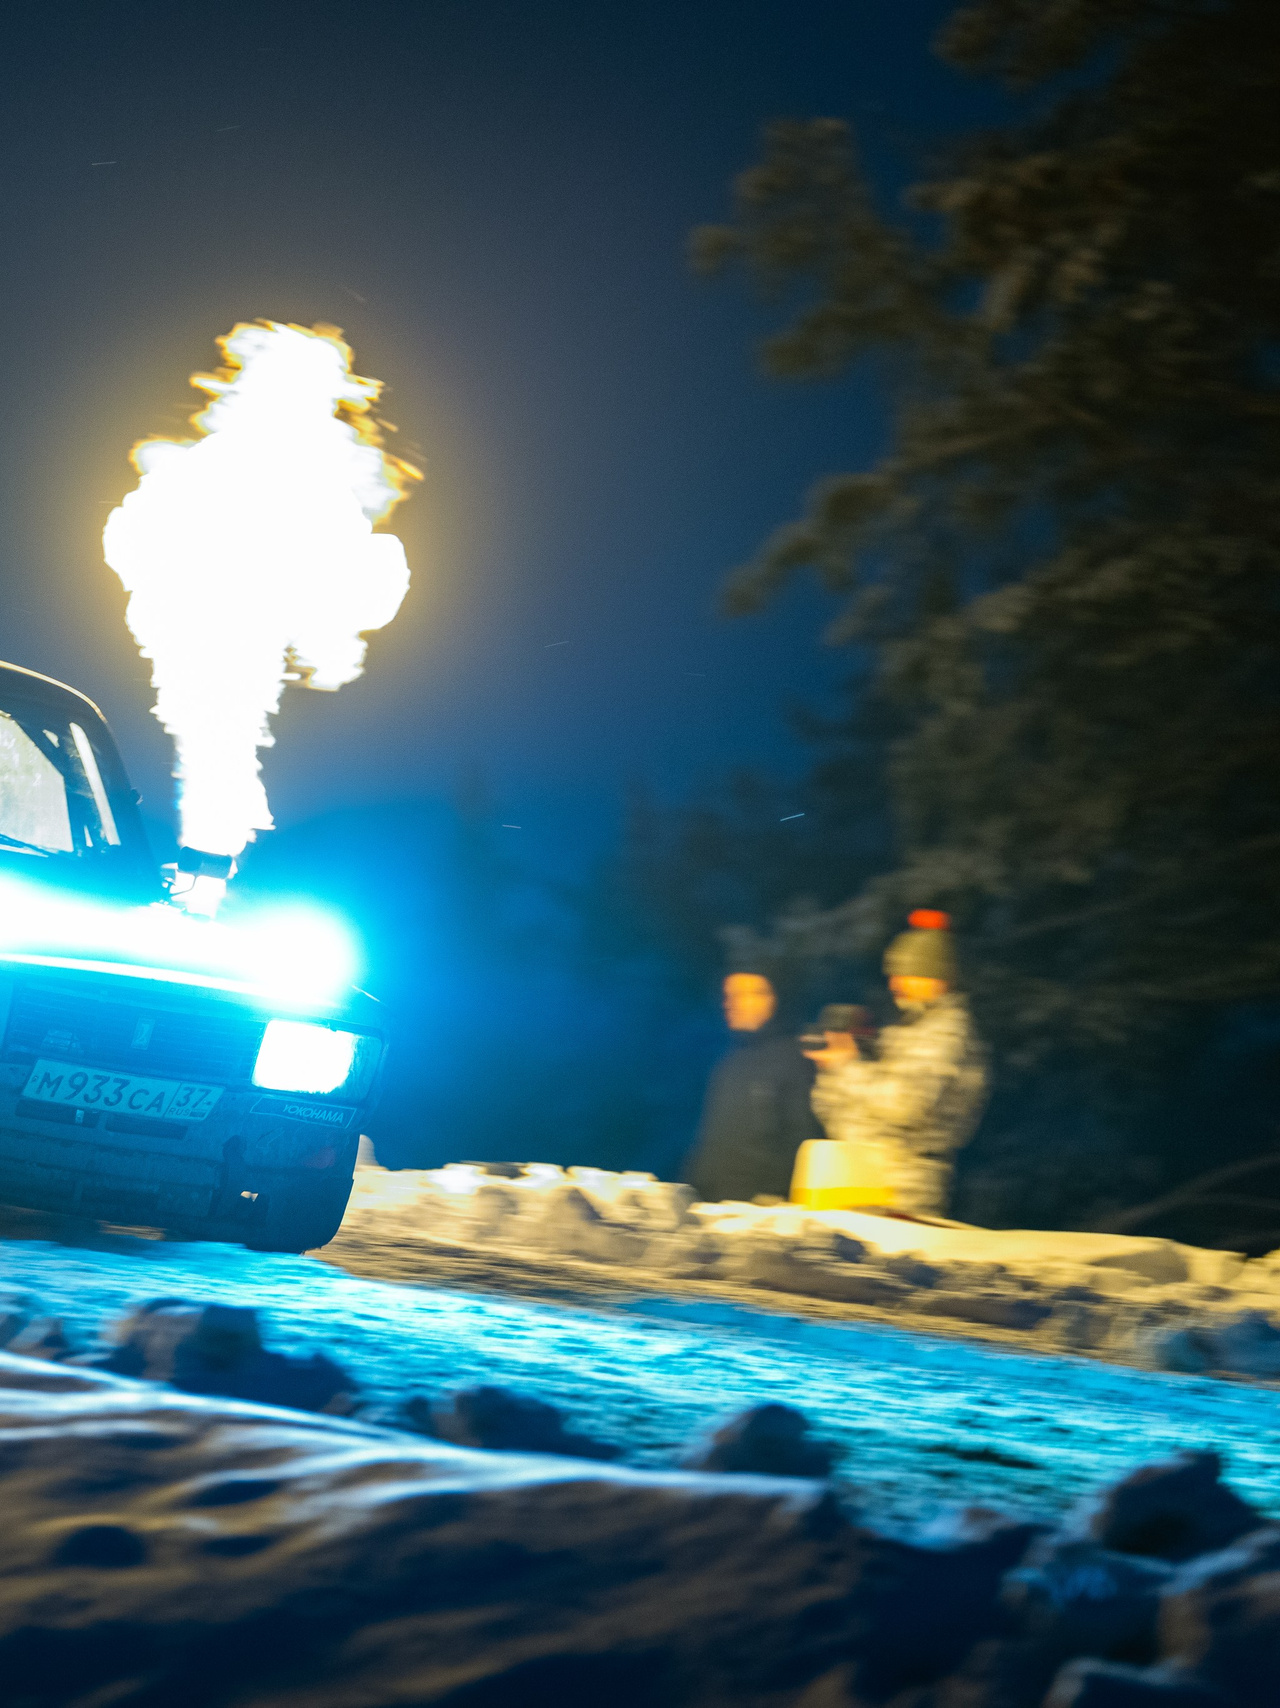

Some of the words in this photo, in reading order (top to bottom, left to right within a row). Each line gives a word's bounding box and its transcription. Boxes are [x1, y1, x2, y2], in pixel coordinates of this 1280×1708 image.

[175, 1086, 213, 1109] 37
[169, 1107, 190, 1117] RUS
[282, 1104, 344, 1124] YOKOHAMA
